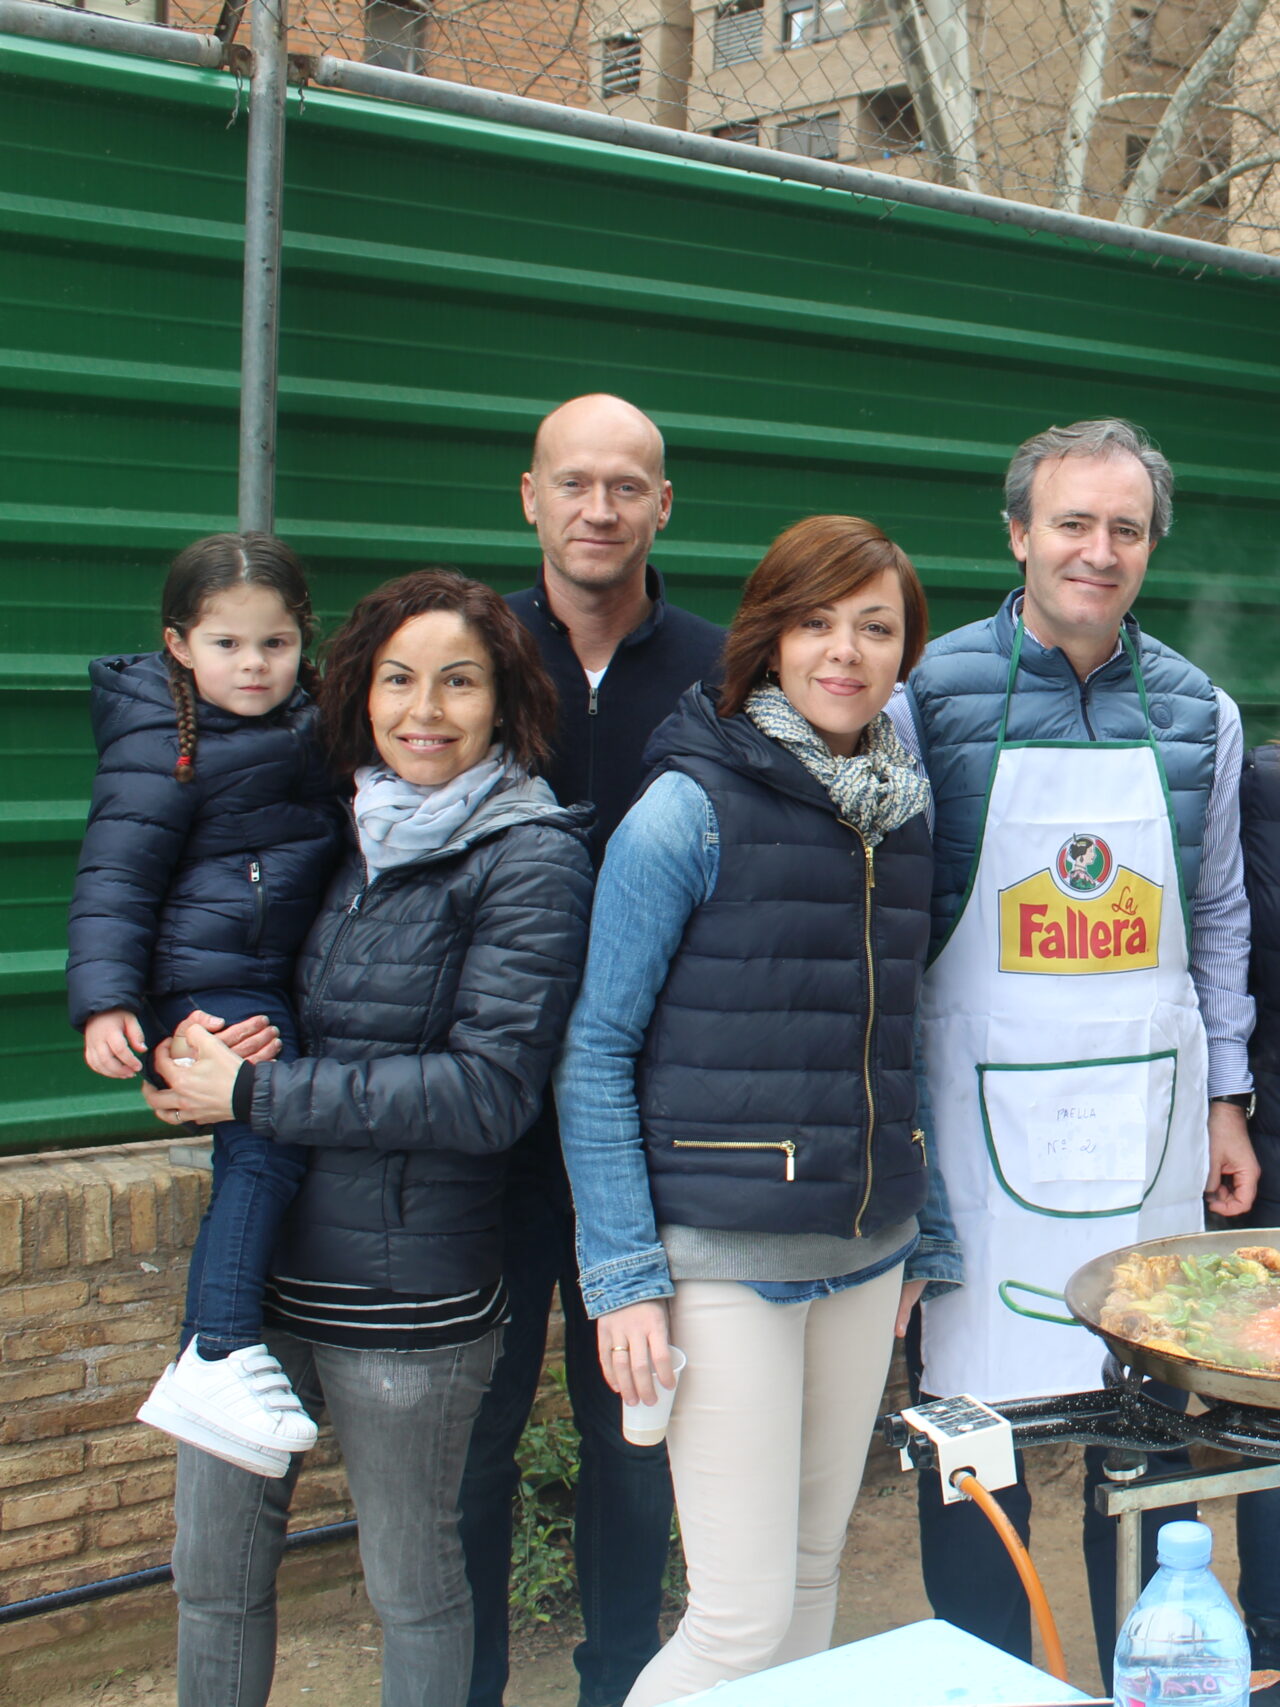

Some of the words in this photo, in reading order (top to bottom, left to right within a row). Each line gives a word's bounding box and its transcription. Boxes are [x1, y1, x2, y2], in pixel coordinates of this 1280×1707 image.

[1111, 886, 1139, 916] La
[1019, 903, 1148, 960] Fallera
[1056, 1107, 1097, 1121] PAELLA
[1080, 1138, 1097, 1154] 2
